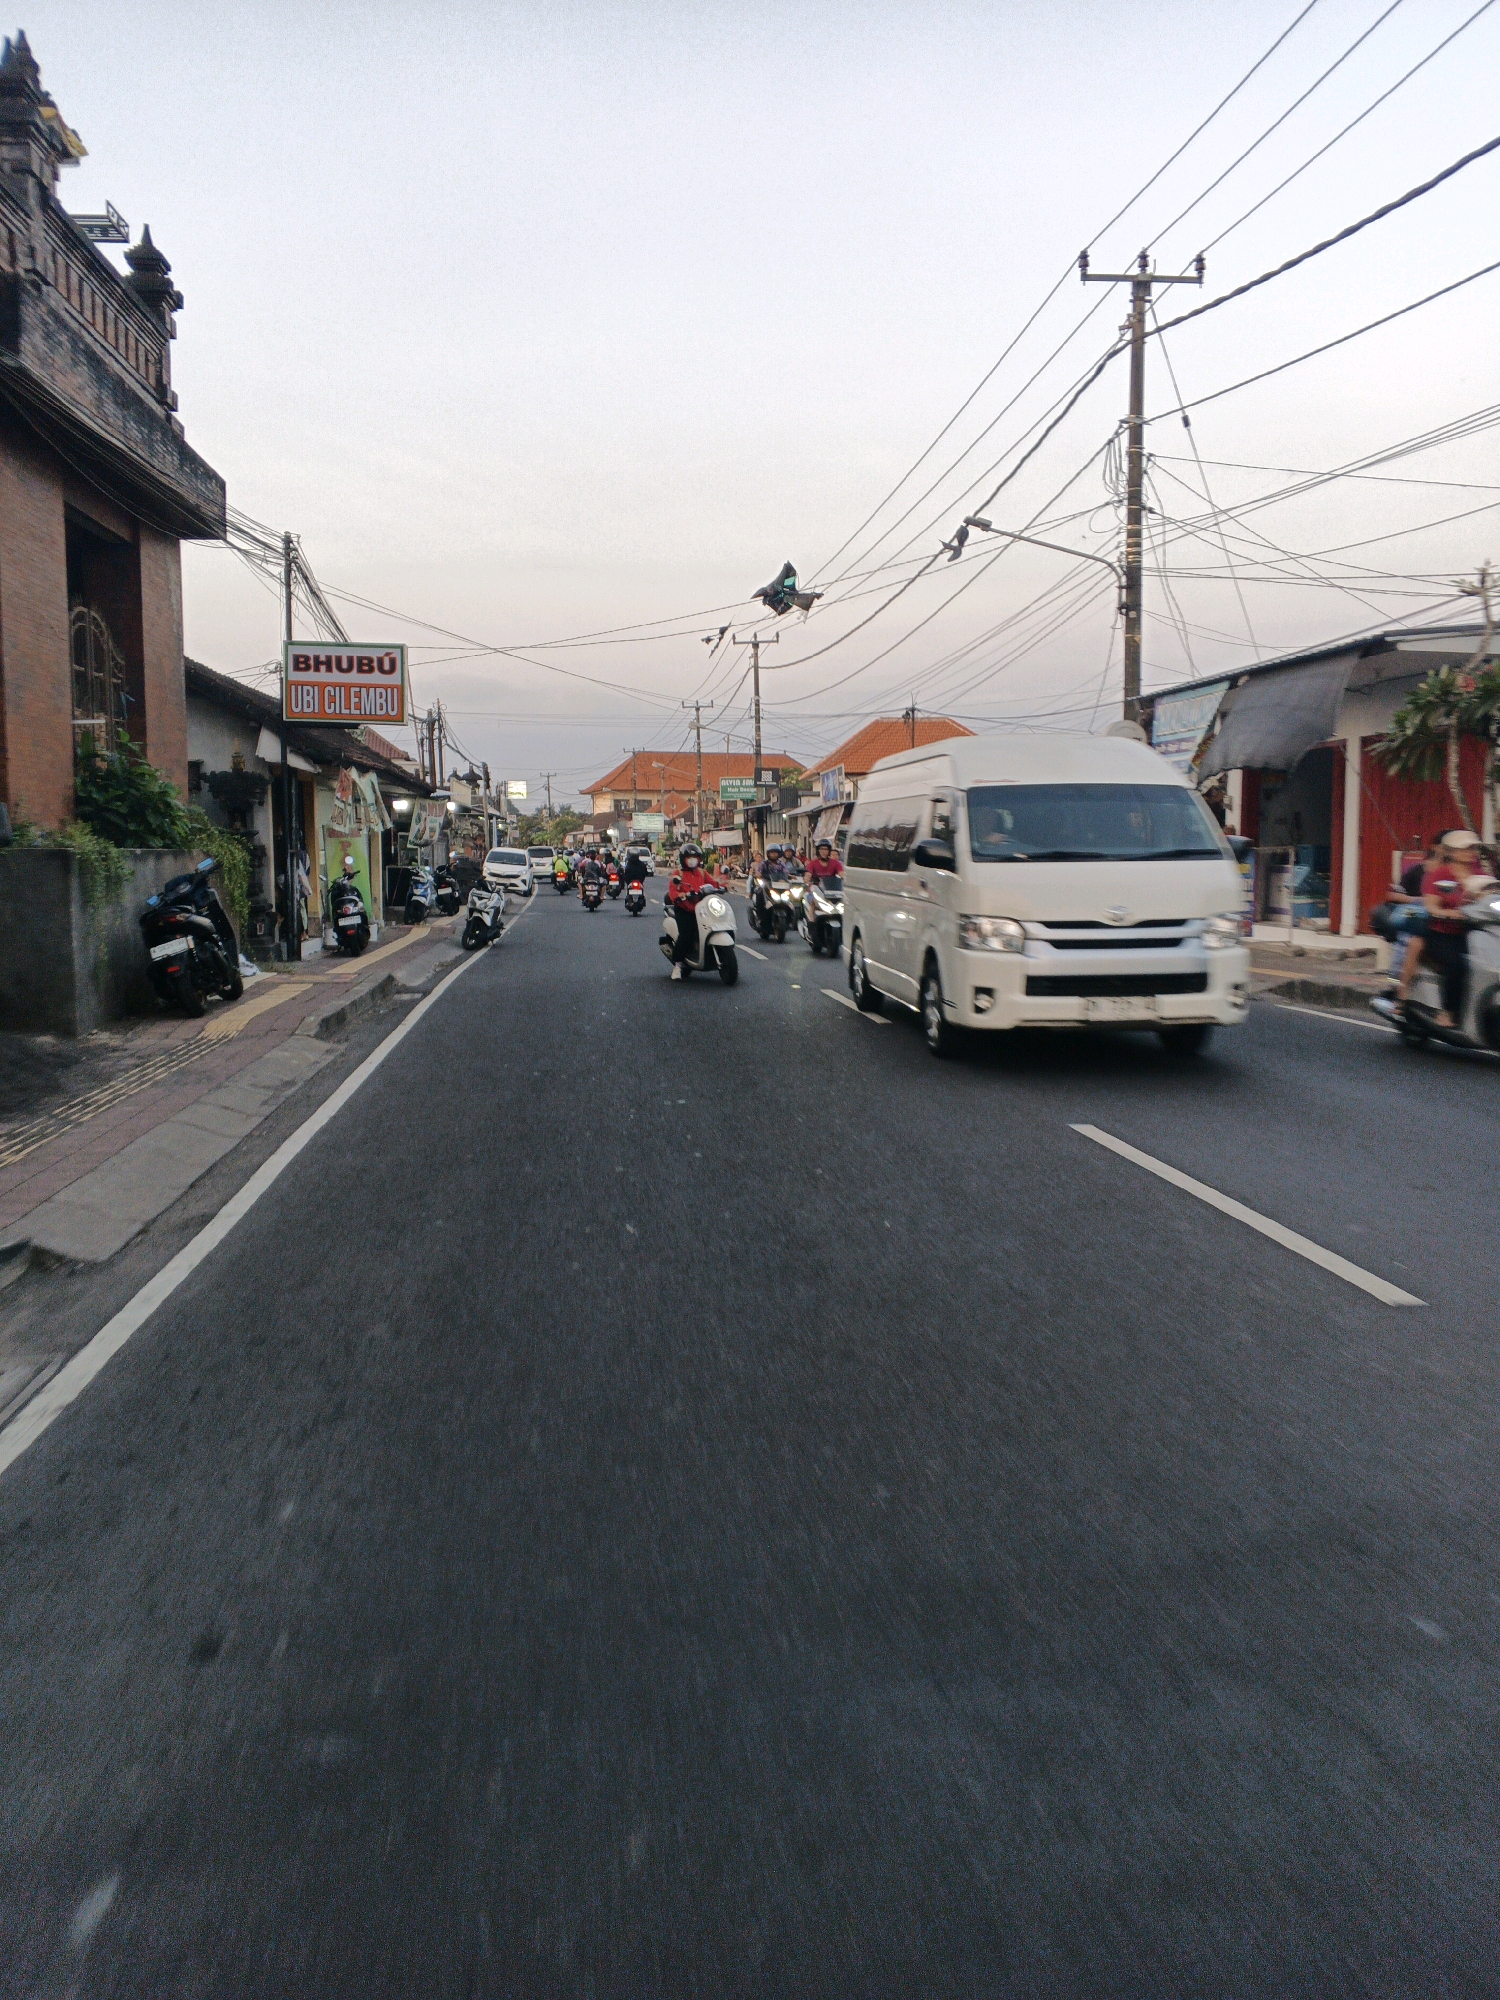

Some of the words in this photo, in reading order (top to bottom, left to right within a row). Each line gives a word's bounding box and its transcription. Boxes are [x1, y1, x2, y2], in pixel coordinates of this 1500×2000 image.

[292, 652, 397, 675] BHUBÚ
[290, 684, 320, 714] UBI
[323, 685, 399, 716] CILEMBU
